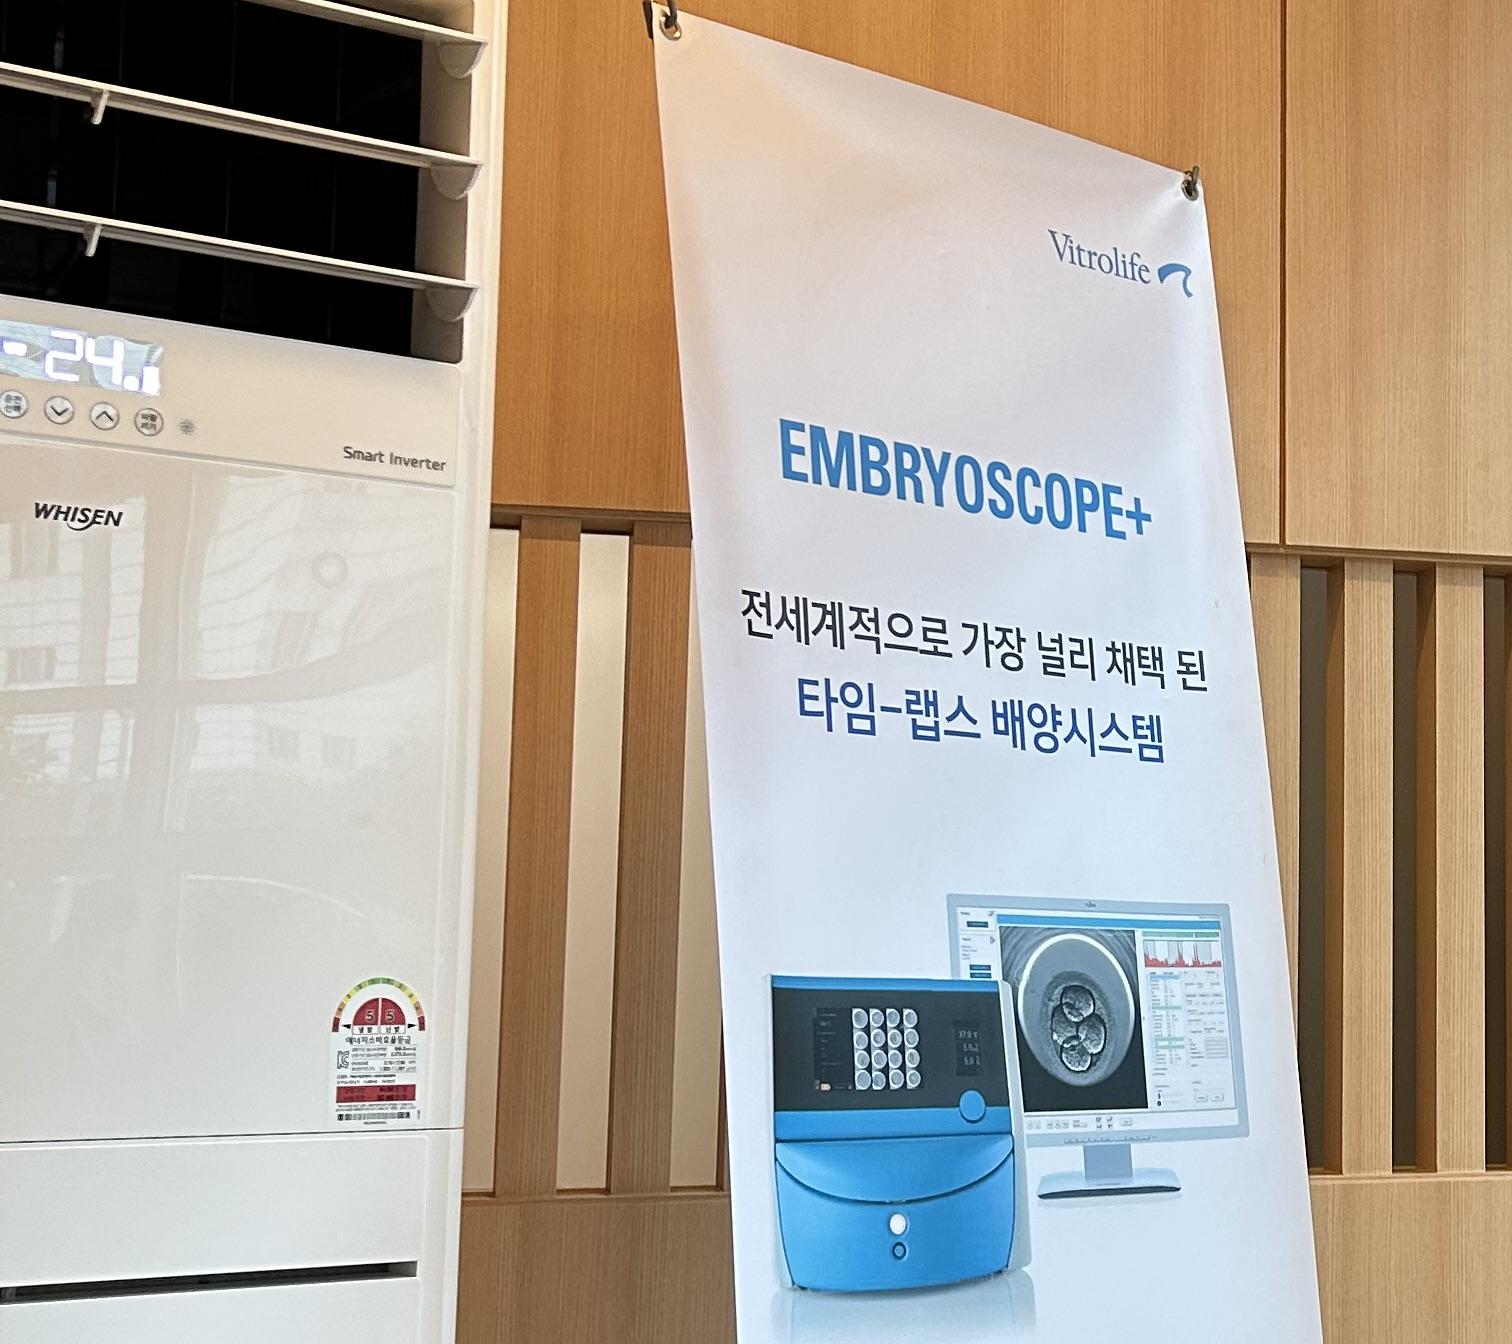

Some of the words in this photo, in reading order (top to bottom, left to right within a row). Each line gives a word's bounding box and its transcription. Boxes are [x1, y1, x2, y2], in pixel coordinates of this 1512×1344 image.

[1047, 228, 1151, 285] Vitrolife
[343, 446, 384, 464] Smart
[390, 452, 446, 471] Inverter
[779, 417, 1152, 540] EMBRYOSCOPE+
[34, 501, 123, 531] WHISEN
[741, 589, 953, 659] 전세계적으로
[962, 621, 1026, 674] 가장
[1037, 631, 1097, 681] 널리
[1105, 640, 1166, 690] 채택
[1176, 650, 1208, 692] 된
[798, 678, 981, 742] 타임-랩스
[992, 699, 1165, 764] 배양시스템
